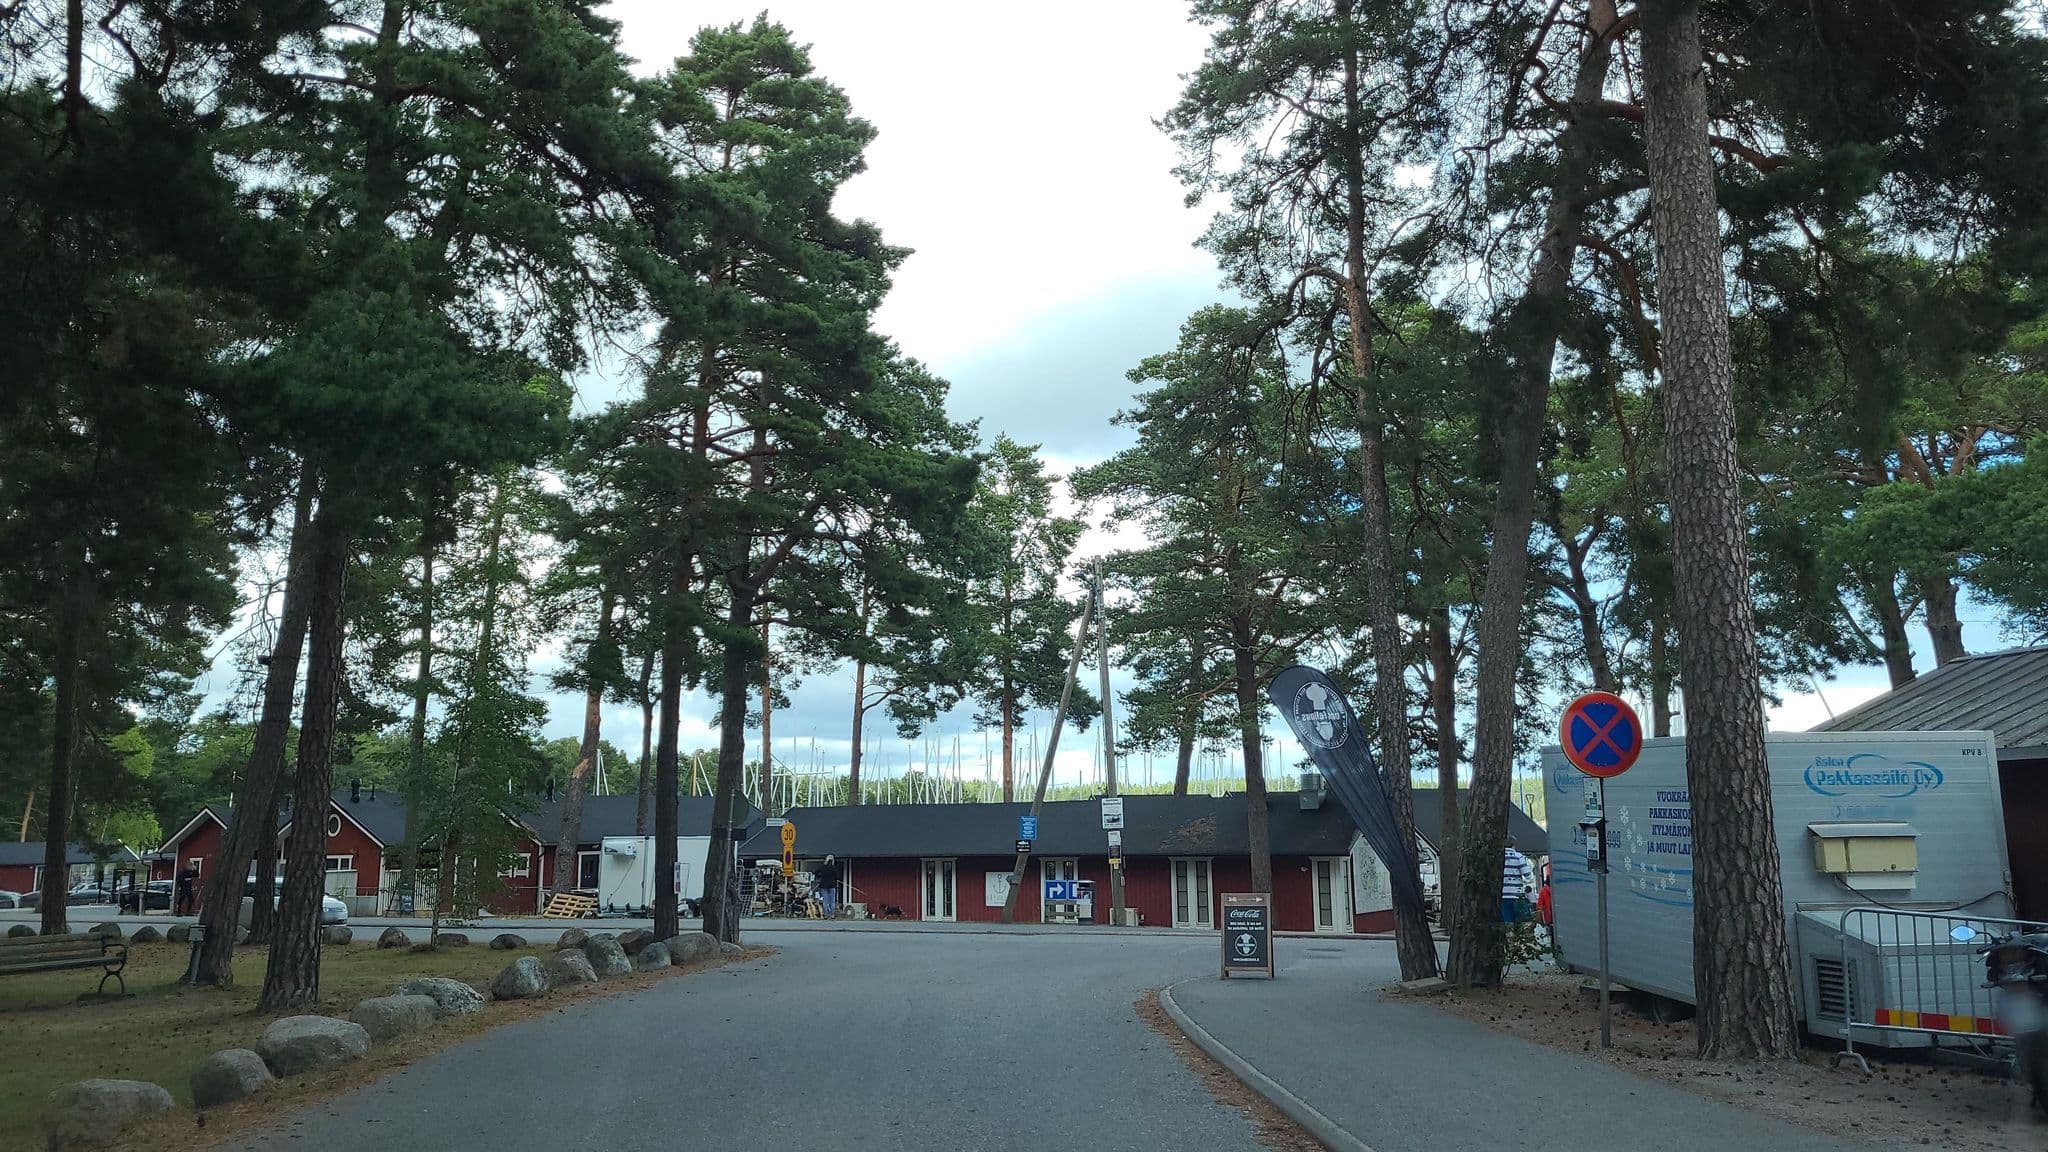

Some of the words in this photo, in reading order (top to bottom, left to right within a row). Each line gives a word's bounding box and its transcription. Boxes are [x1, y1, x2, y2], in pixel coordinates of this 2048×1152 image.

[1962, 748, 1976, 756] KPV
[1815, 756, 1844, 767] Salon
[1816, 769, 1910, 786] Pakkassäilö
[1914, 769, 1934, 788] Oy
[784, 829, 793, 841] 30
[1655, 842, 1677, 854] MUUT
[1230, 909, 1261, 918] Coca-Cola
